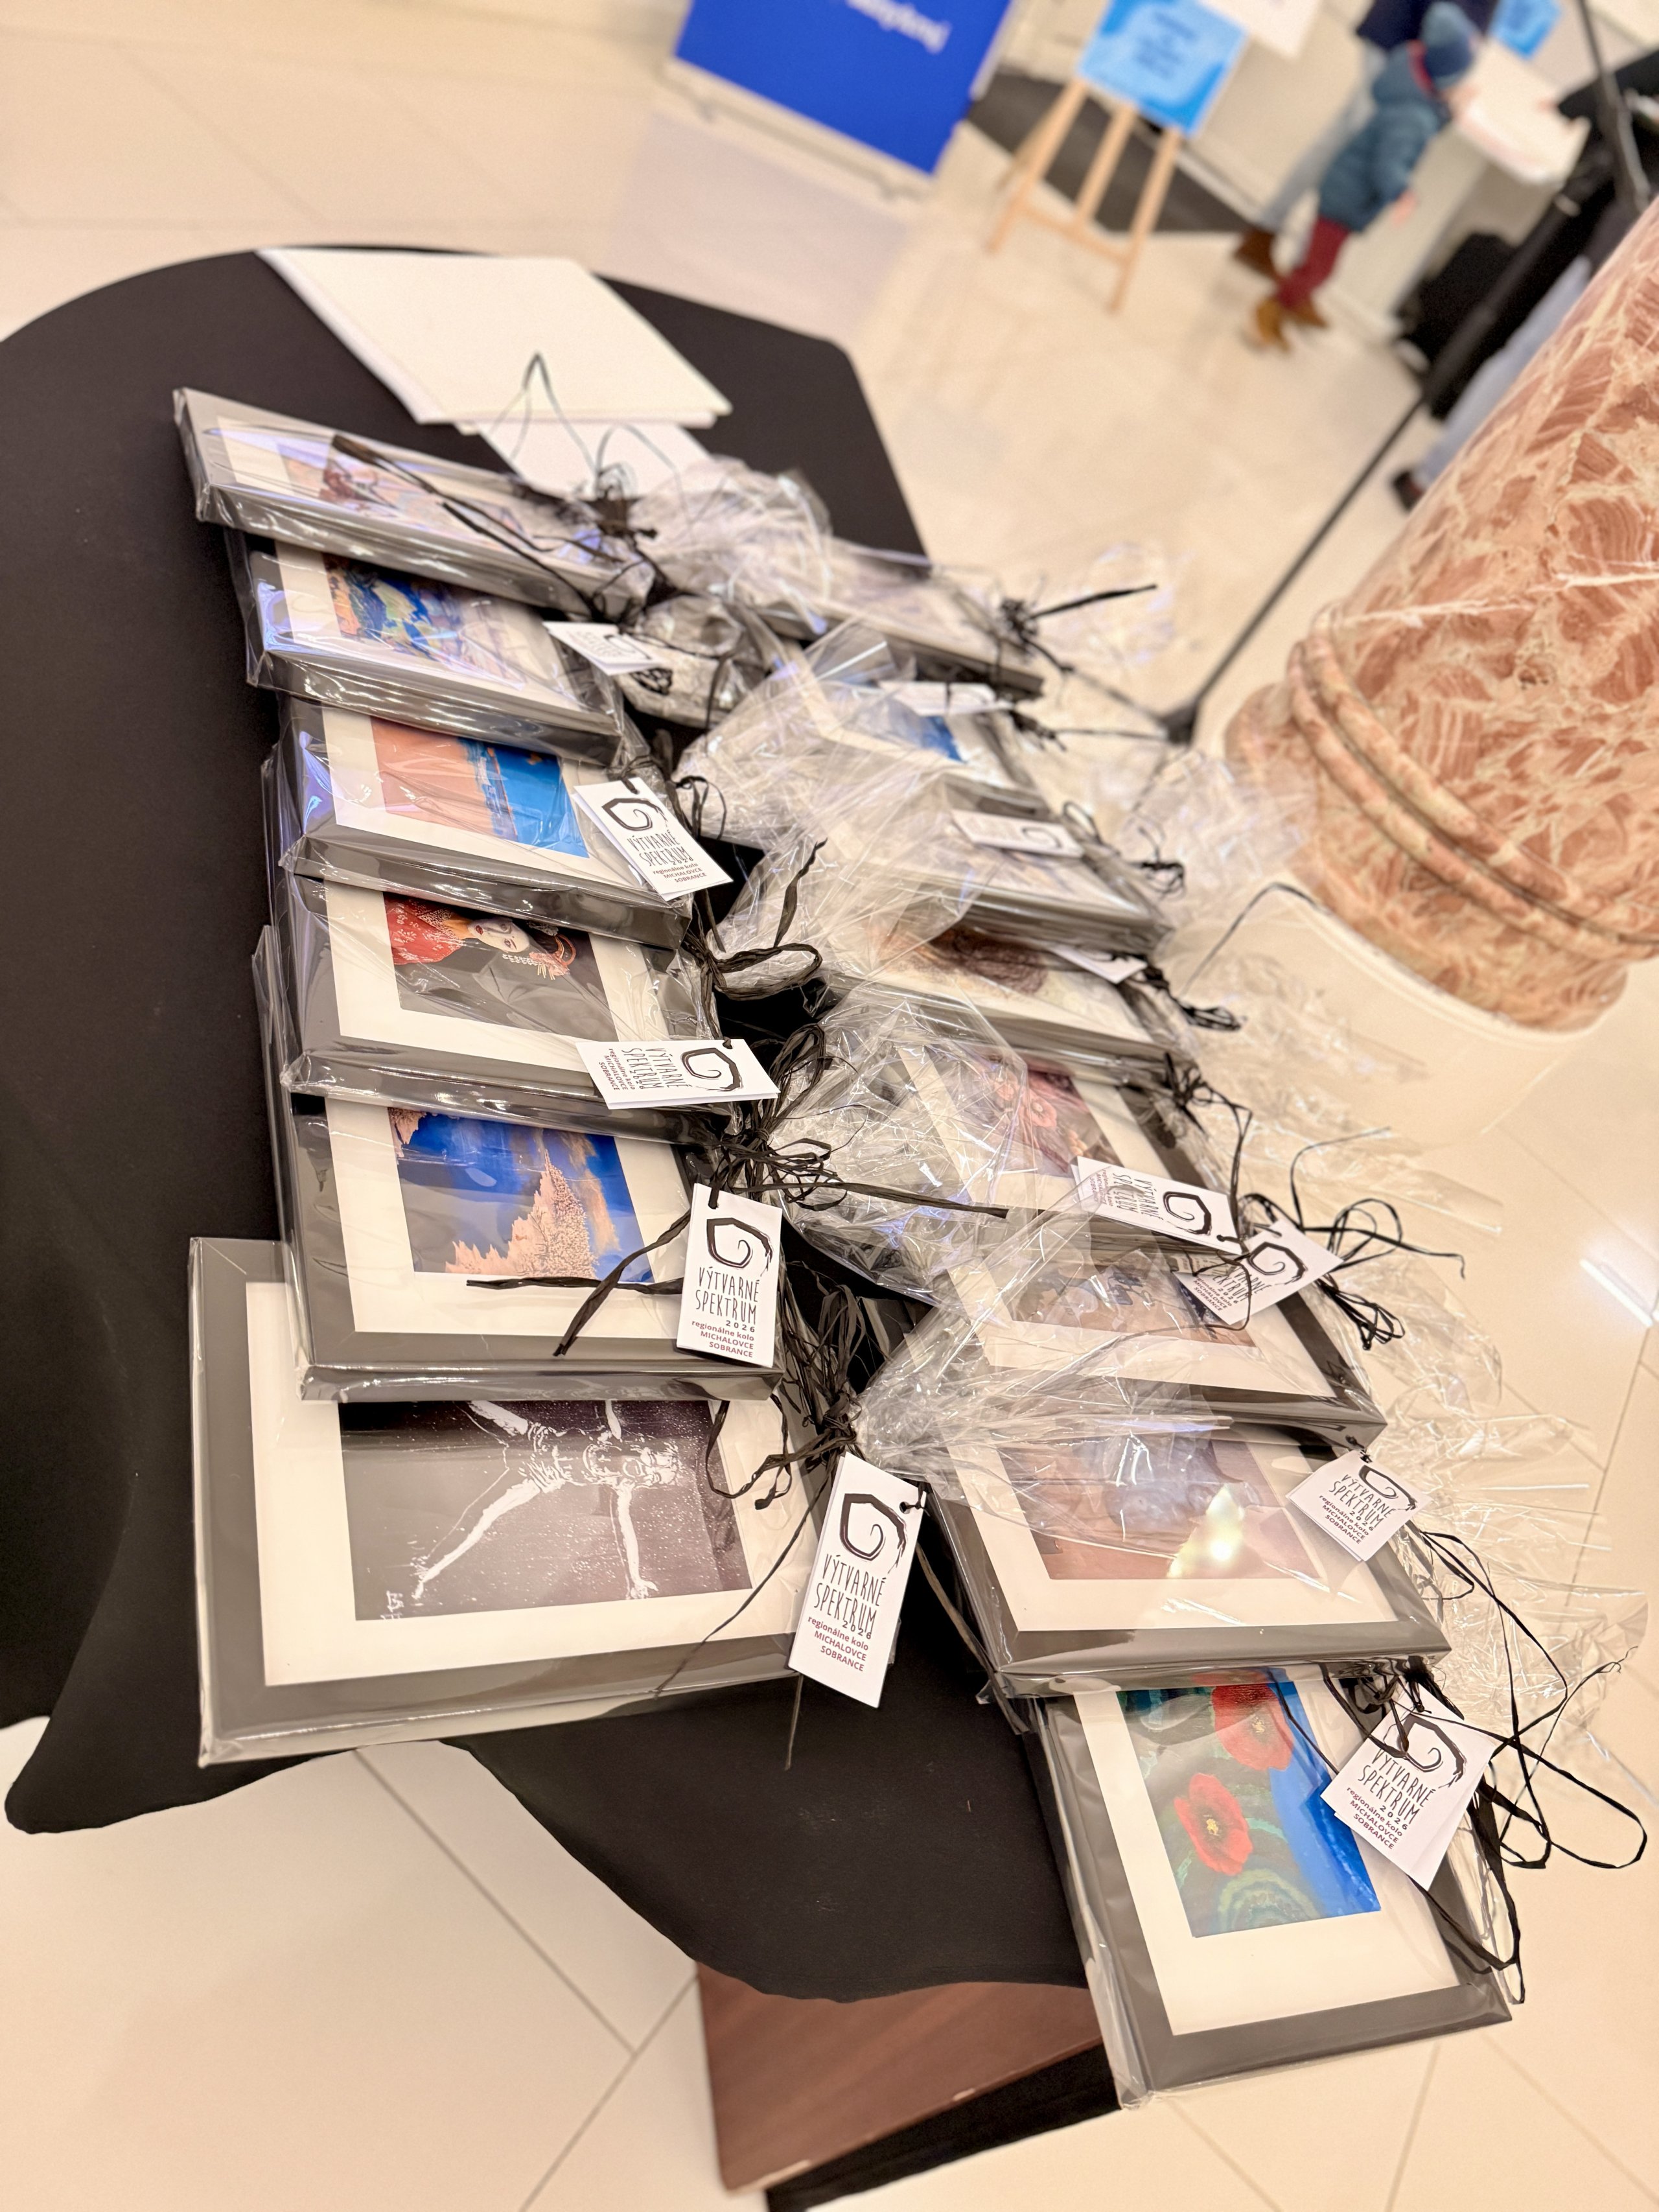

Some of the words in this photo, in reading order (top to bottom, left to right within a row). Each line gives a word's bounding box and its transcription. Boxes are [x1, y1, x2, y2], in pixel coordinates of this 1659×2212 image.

[627, 830, 680, 852] VÝTVARNÉ
[640, 846, 691, 866] SPEKTRUM
[653, 865, 684, 875] regionálne
[664, 867, 702, 879] MICHALOVCE
[675, 873, 706, 883] SOBRANCE
[599, 1062, 620, 1091] SOBRANCE
[603, 1055, 628, 1090] MICHALOVCE
[609, 1048, 627, 1078] regionálne
[625, 1078, 635, 1090] kolo
[621, 1048, 664, 1089] SPEKTRUM
[645, 1048, 692, 1088] VÝTVARNÉ
[699, 1266, 760, 1303] VÝTVARNÉ
[1193, 1280, 1228, 1309] MICHALOVCE
[1194, 1286, 1223, 1311] SOBRANCE
[1195, 1275, 1220, 1297] egionálne
[1220, 1296, 1233, 1306] kolo
[1218, 1288, 1239, 1304] 2026
[695, 1289, 756, 1325] SPEKTRUM
[691, 1320, 735, 1337] regionálne
[736, 1329, 754, 1342] kolo
[700, 1331, 754, 1350] MICHALOVCE
[725, 1320, 756, 1333] 2026
[709, 1341, 753, 1358] SOBRANCE
[1328, 1481, 1384, 1528] SPEKTRUM
[1341, 1474, 1396, 1519] VÝTVARNÉ
[1319, 1495, 1354, 1524] regionálne
[1354, 1523, 1369, 1535] kolo
[1322, 1505, 1366, 1541] MICHALOVCE
[1325, 1514, 1362, 1544] SOBRANCE
[1349, 1510, 1374, 1531] 2026
[822, 1554, 887, 1607] VÝTVARNÉ
[814, 1583, 877, 1634] SPEKTRUM
[807, 1616, 850, 1642] regionálne
[851, 1636, 868, 1651] kolo
[814, 1630, 866, 1661] MICHALOVCE
[842, 1620, 872, 1640] 2026
[820, 1646, 864, 1671] SOBRANCE
[1358, 1765, 1420, 1824] SPEKTRUM
[1347, 1787, 1385, 1822] regionálne
[1386, 1821, 1403, 1837] kolo
[1350, 1800, 1399, 1843] MICHALOVCE
[1379, 1805, 1408, 1830] 2026
[1353, 1813, 1395, 1850] SOBRANCE
